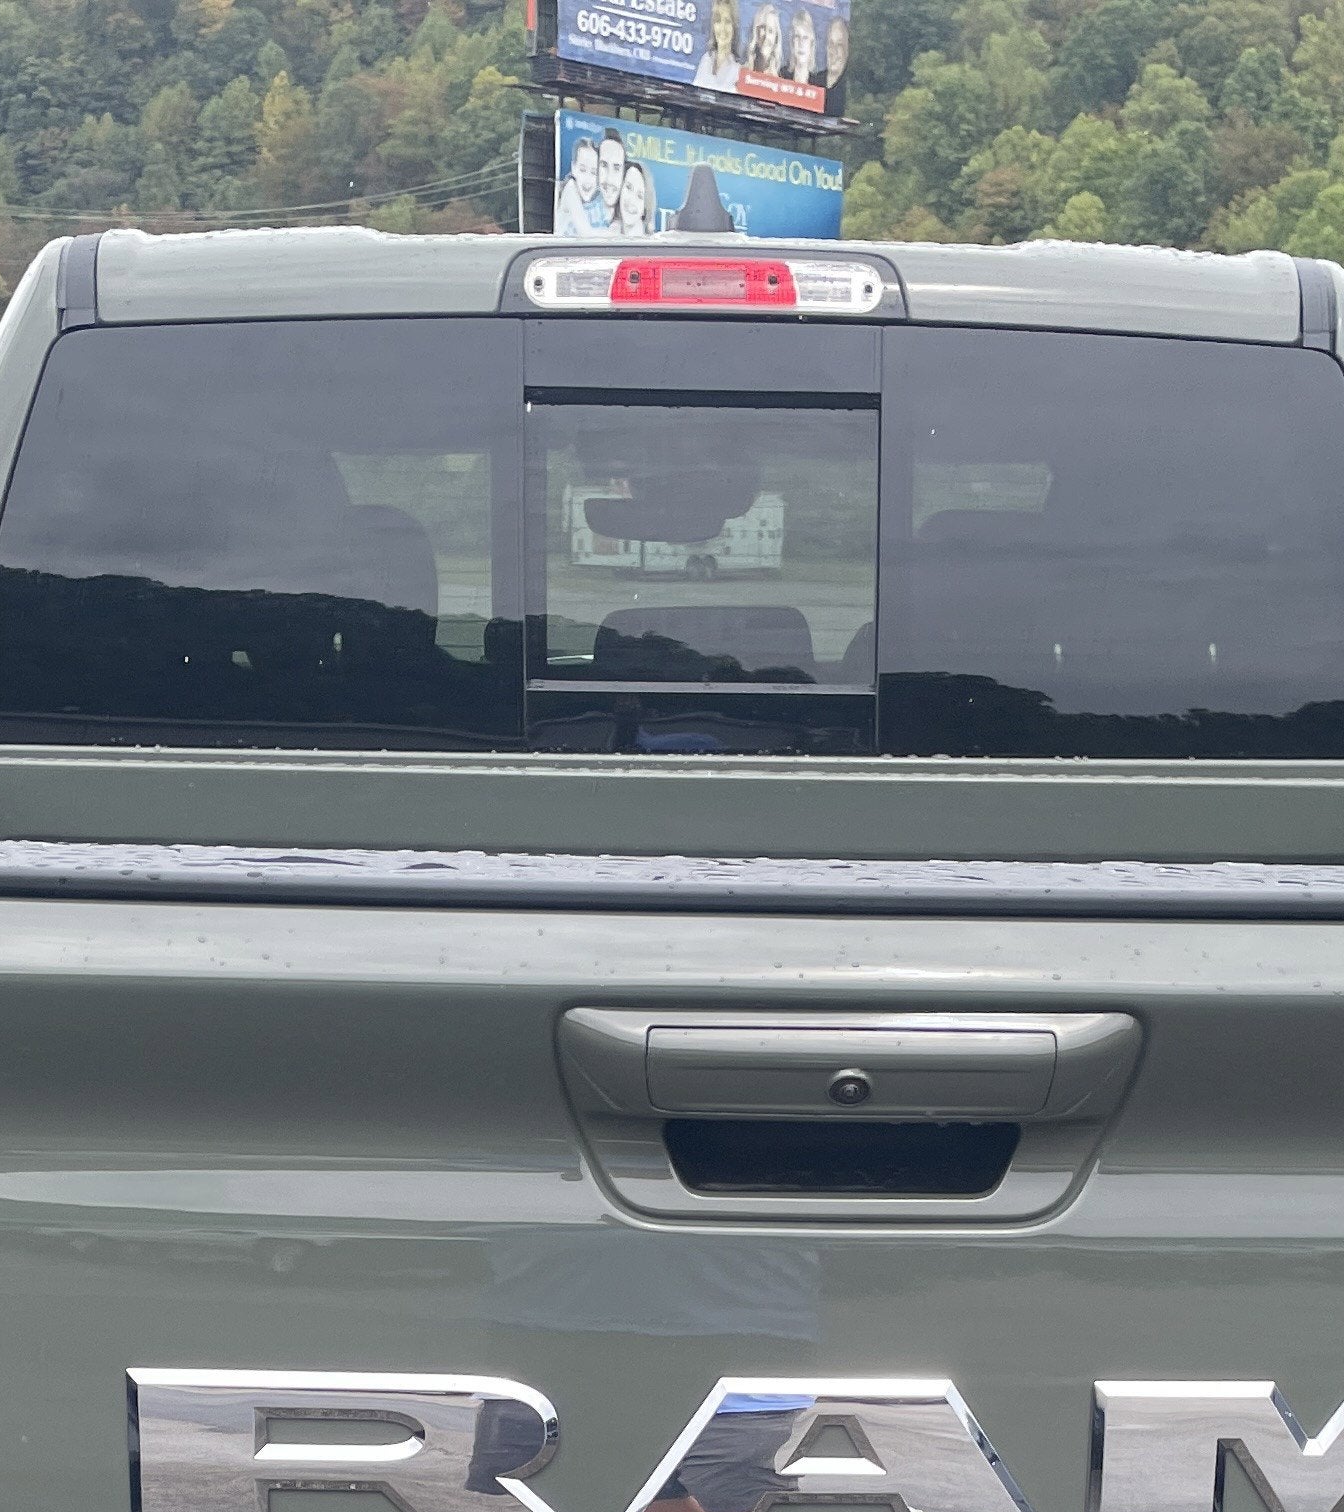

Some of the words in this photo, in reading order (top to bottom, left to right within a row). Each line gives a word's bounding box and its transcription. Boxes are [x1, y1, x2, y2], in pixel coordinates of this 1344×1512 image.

[576, 9, 694, 54] 606-433-9700
[744, 153, 787, 182] Good
[789, 161, 812, 186] On
